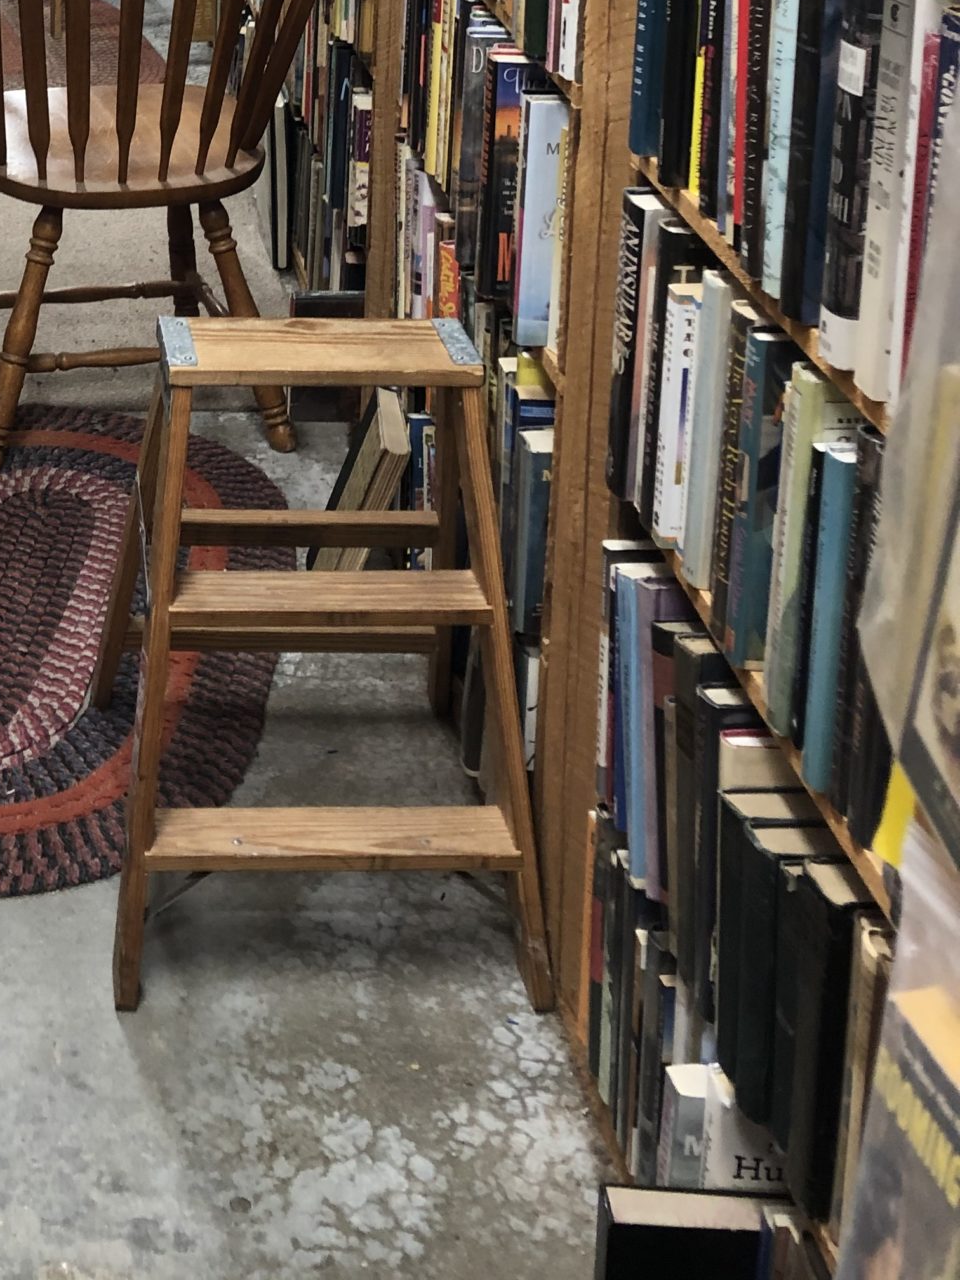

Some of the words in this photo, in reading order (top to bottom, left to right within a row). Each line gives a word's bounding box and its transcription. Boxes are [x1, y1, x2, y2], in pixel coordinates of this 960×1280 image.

[632, 42, 645, 98] MINOT
[623, 219, 641, 257] AN
[619, 258, 638, 341] INSULAR
[733, 349, 746, 382] The
[725, 386, 742, 426] Very
[722, 441, 740, 484] Rich
